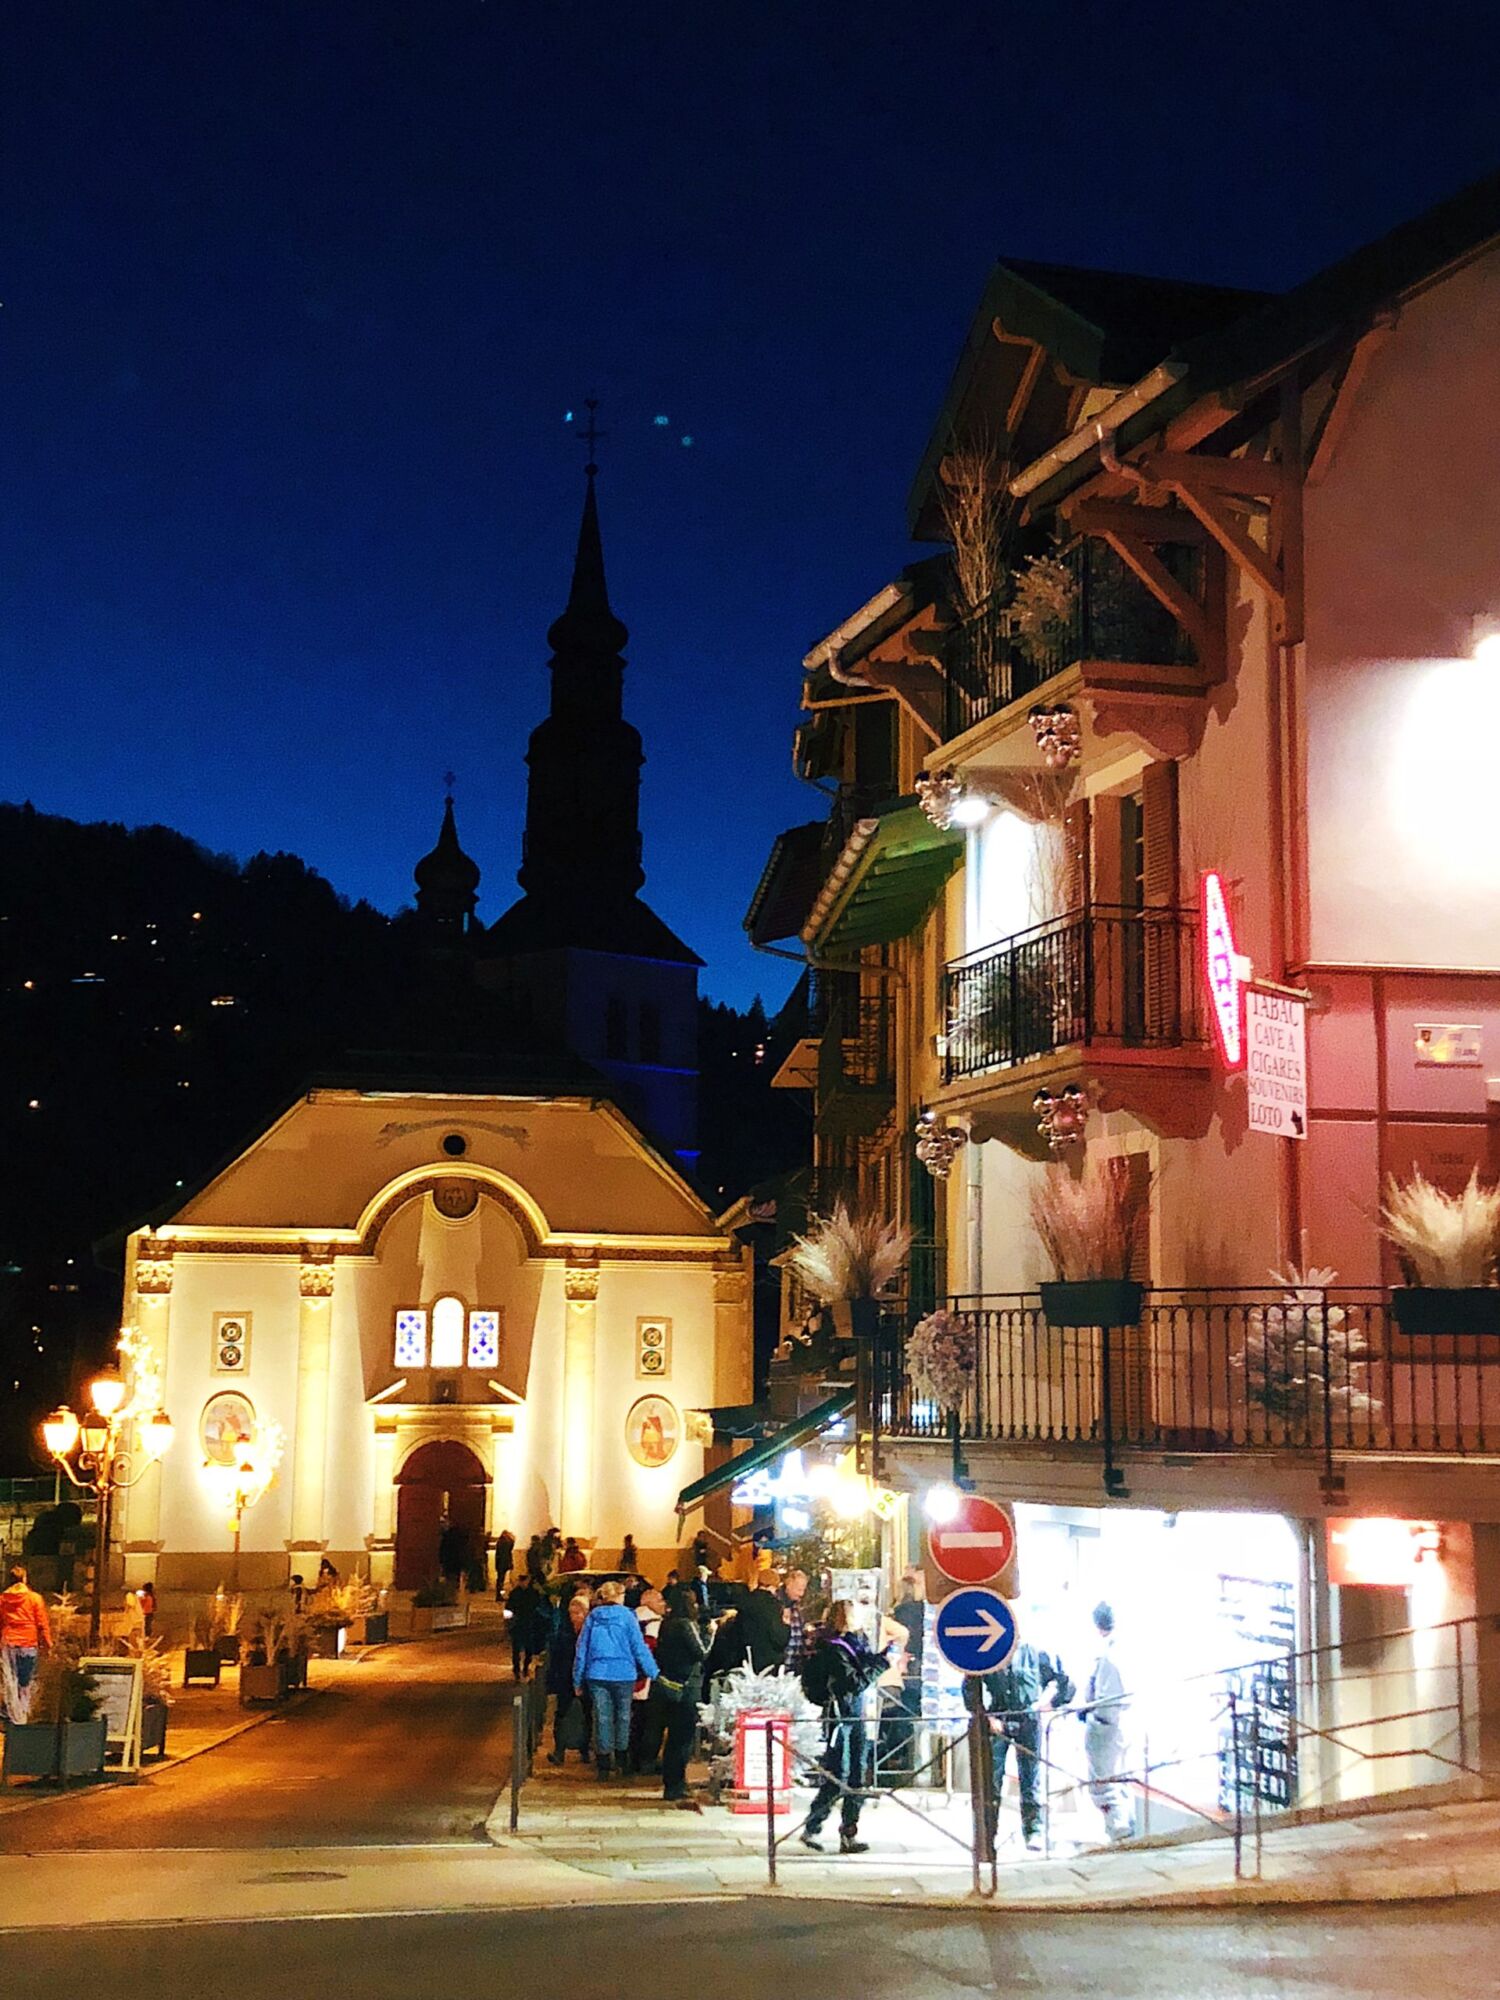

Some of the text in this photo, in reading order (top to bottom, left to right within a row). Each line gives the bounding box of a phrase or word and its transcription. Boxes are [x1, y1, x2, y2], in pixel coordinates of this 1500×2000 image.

[1253, 994, 1299, 1027] TABAC
[1255, 1022, 1285, 1050] CAVE
[1251, 1050, 1301, 1082] CIGARES
[1249, 1076, 1304, 1105] SOUVENIRS
[1251, 1102, 1283, 1129] LOTO
